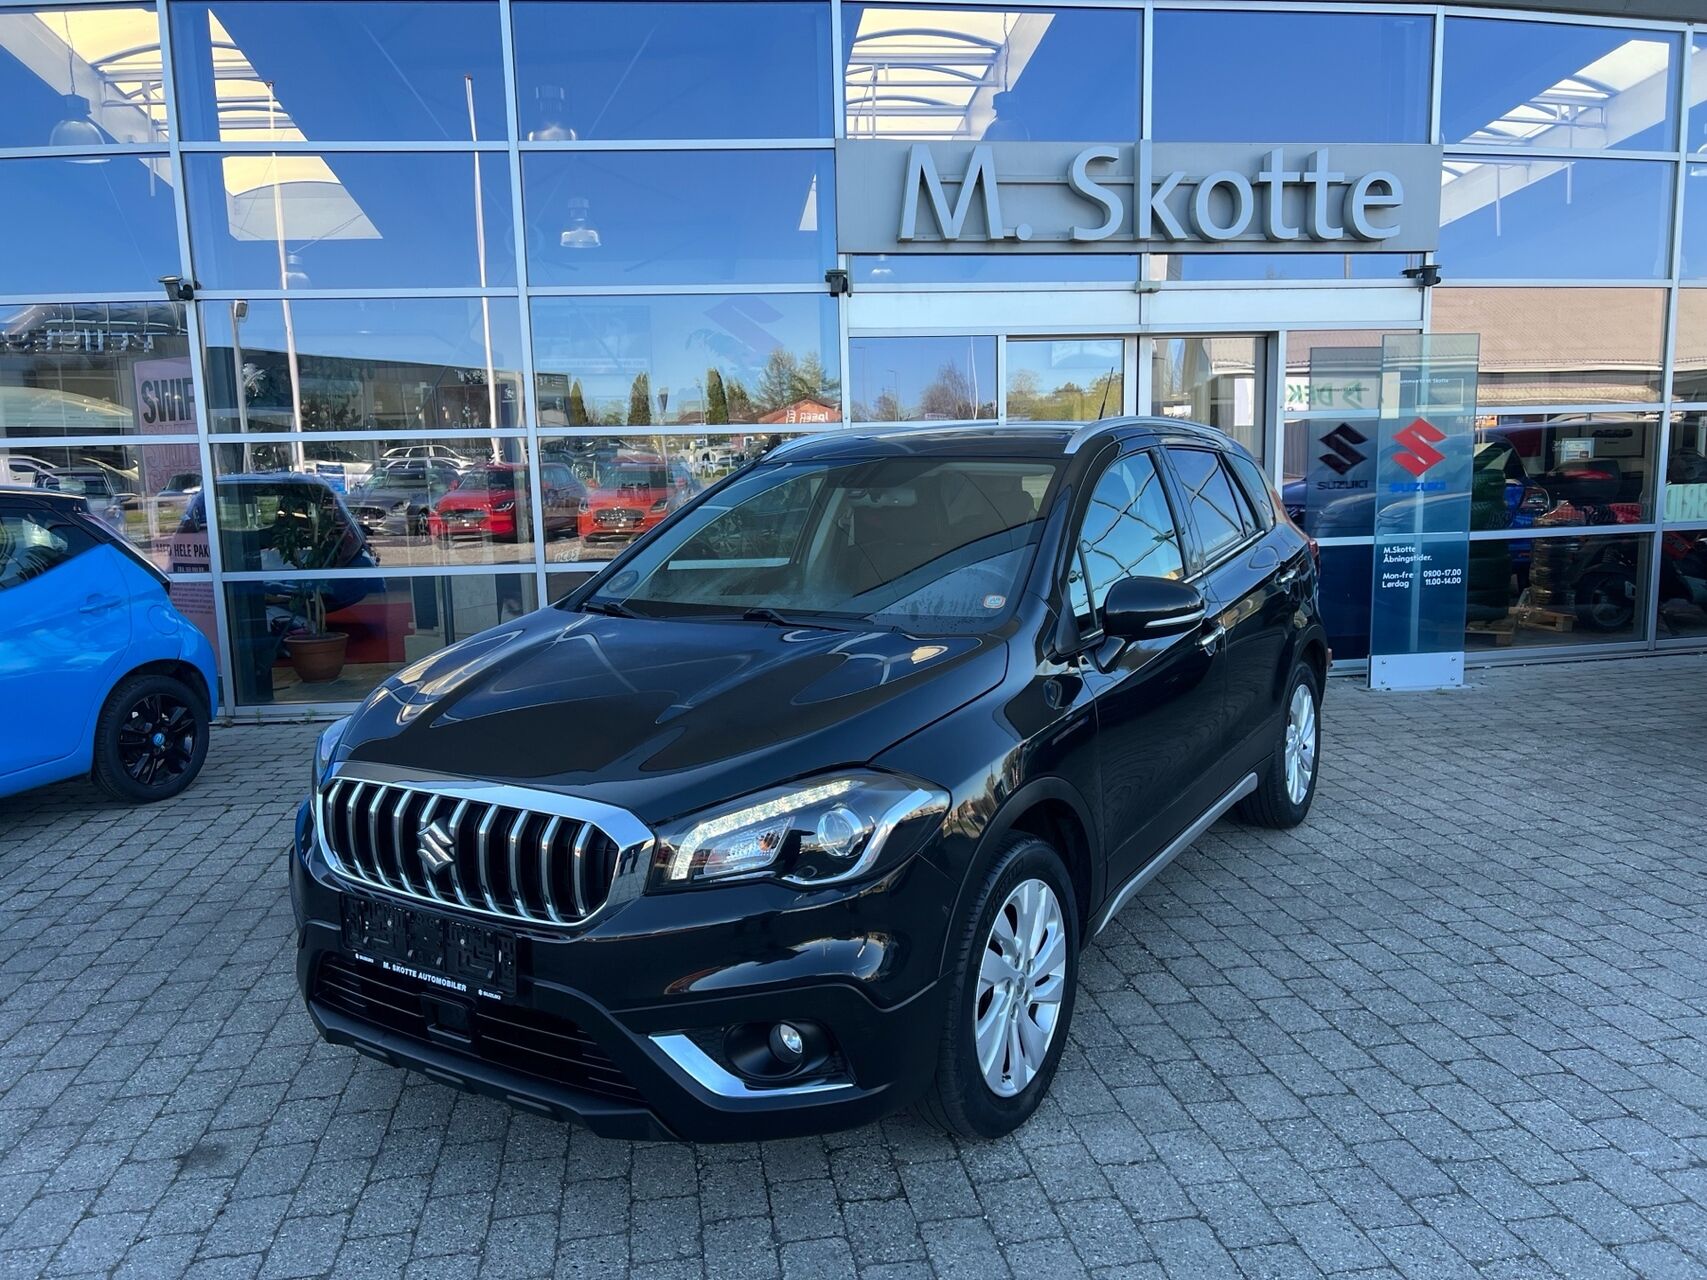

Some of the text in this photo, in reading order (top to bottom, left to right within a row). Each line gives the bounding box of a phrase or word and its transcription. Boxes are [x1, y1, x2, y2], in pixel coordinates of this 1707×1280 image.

[898, 139, 1404, 242] M. Skotte
[1316, 480, 1369, 490] SUZUKI
[1391, 481, 1447, 493] SUZUKI
[174, 543, 192, 558] HELE
[1383, 546, 1416, 554] M.Skotte
[1383, 554, 1433, 563] Åbningstider.
[382, 961, 467, 992] M. SKOTTE AUTOMOBILER
